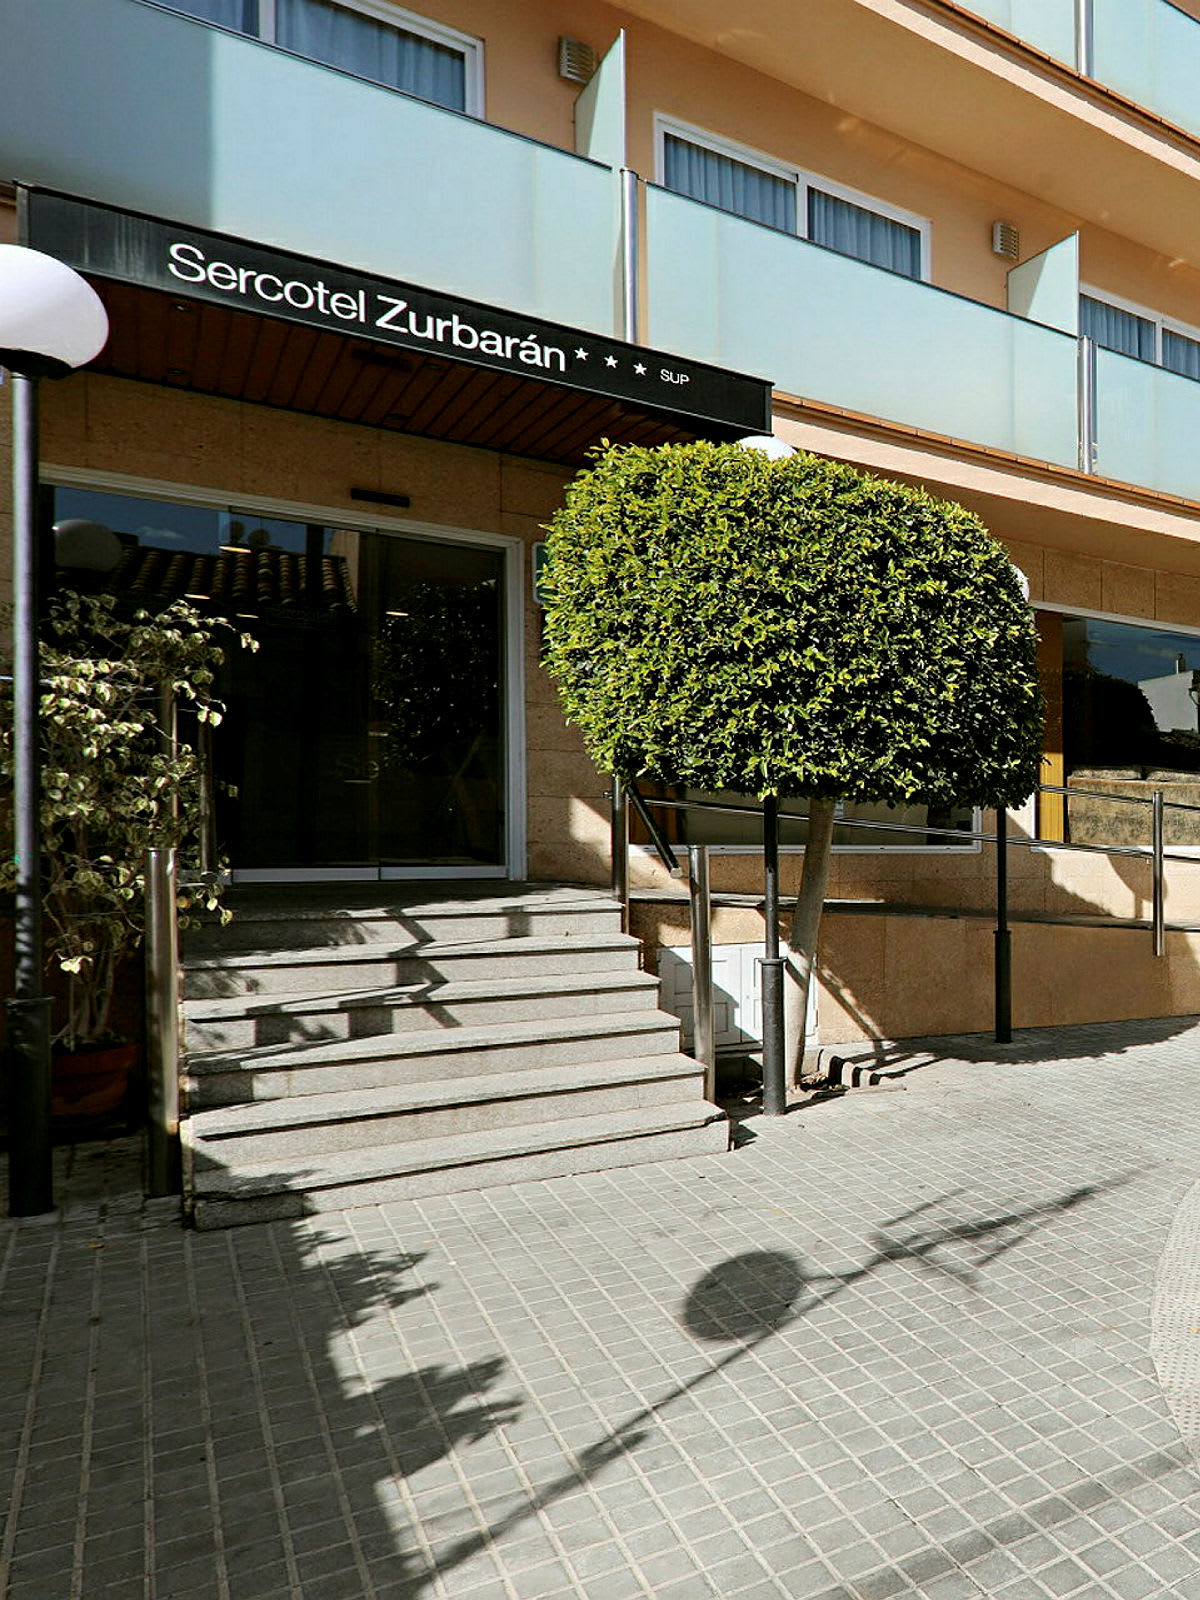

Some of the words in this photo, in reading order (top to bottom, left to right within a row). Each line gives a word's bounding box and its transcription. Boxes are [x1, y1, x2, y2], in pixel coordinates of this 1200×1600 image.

[167, 242, 367, 324] Sercotel
[375, 295, 567, 373] Zurbarán
[659, 367, 691, 387] SUP
